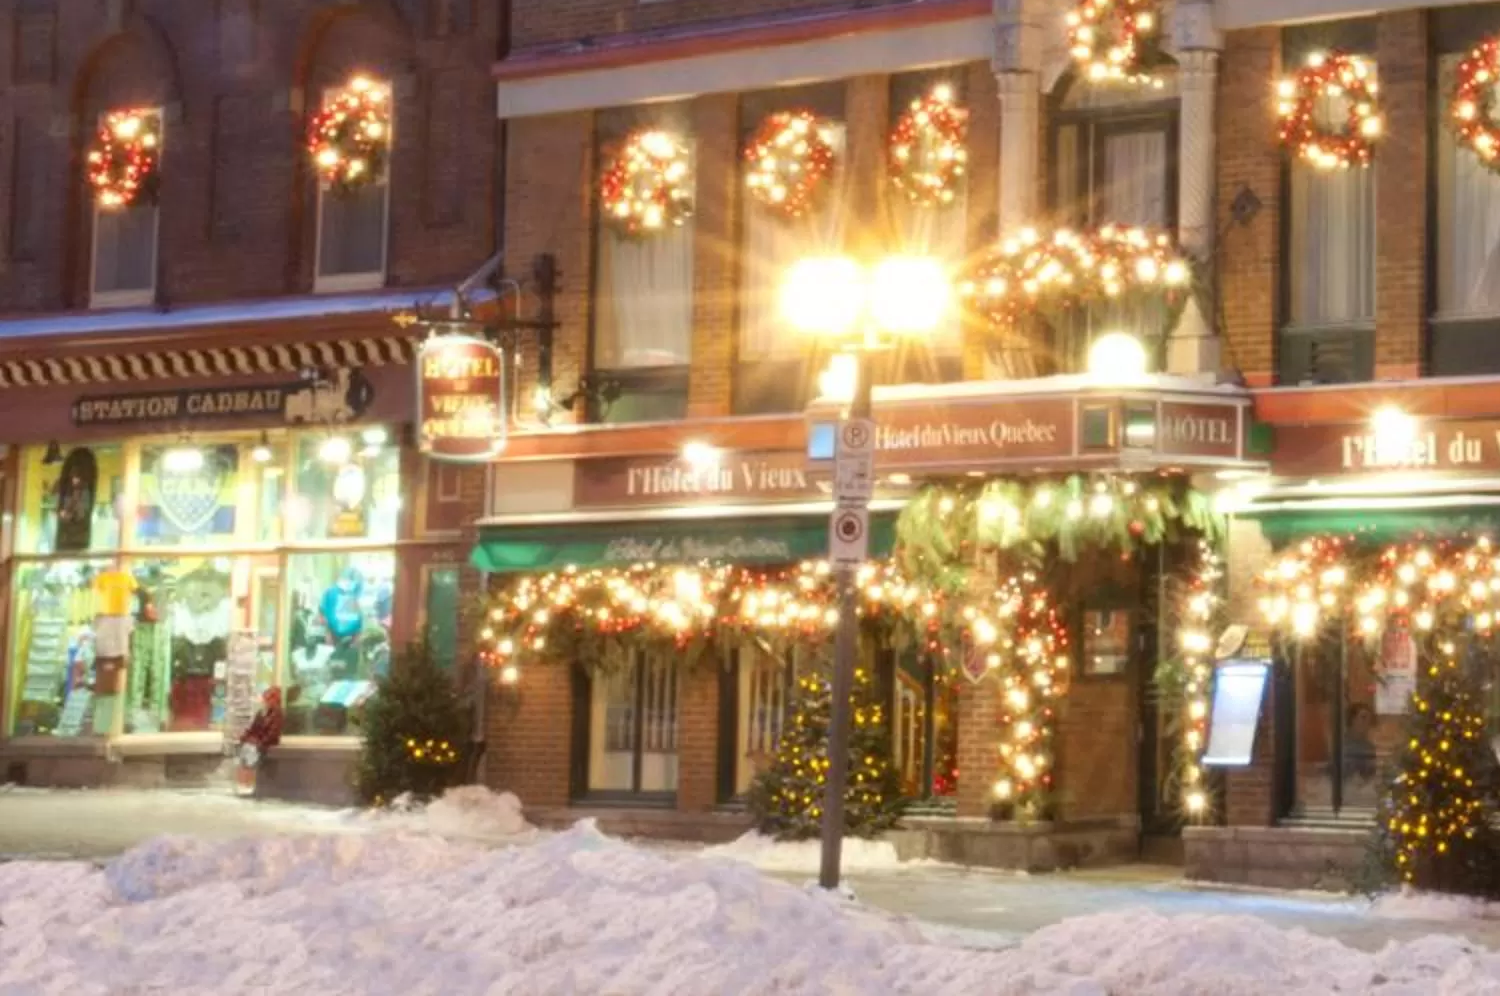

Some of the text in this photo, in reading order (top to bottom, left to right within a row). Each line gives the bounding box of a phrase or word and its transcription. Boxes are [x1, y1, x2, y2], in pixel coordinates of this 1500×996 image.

[942, 422, 988, 446] Vieux
[1448, 431, 1482, 464] du
[707, 459, 734, 491] du
[741, 460, 807, 492] Vieux
